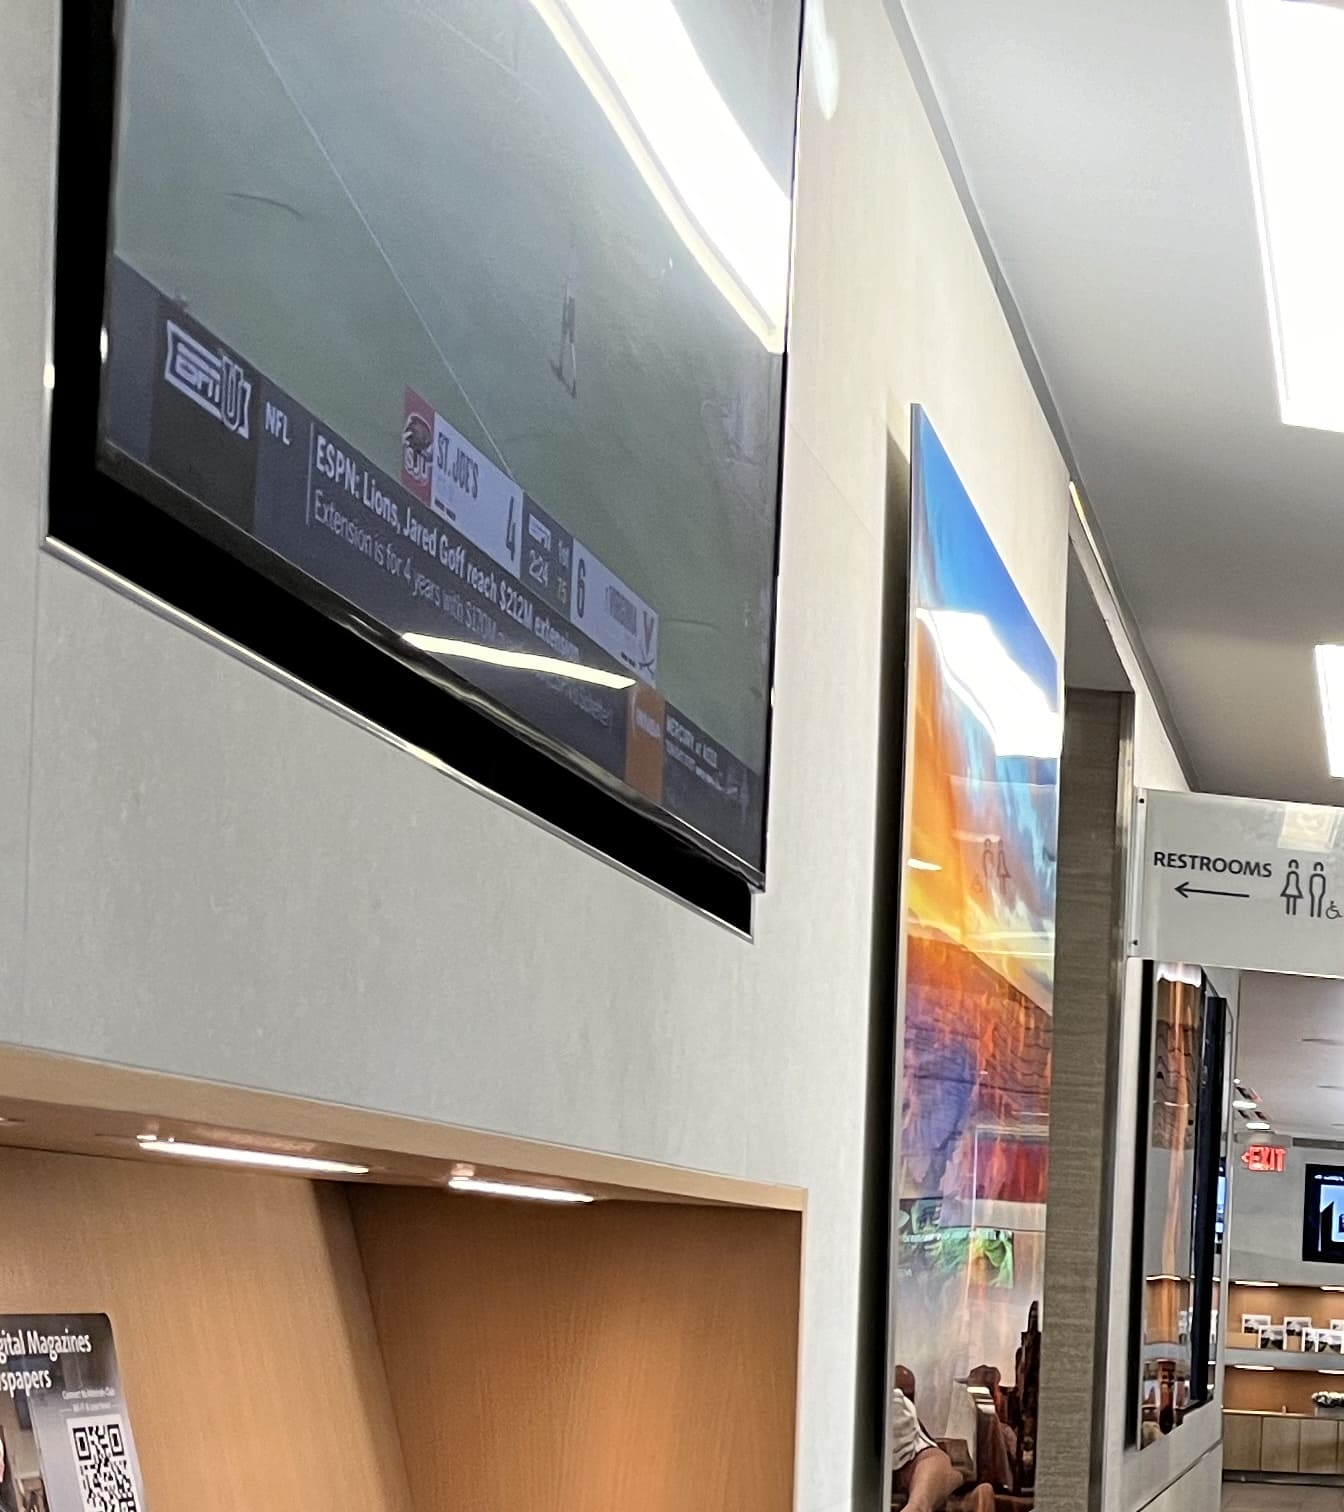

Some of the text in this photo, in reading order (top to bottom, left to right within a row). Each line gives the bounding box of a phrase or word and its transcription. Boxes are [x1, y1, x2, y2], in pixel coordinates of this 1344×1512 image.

[265, 401, 290, 446] NFL
[314, 488, 373, 558] Extension
[374, 536, 385, 566] is
[386, 542, 402, 576] for
[315, 434, 361, 499] ESPN:
[362, 471, 401, 534] Lions,
[403, 507, 437, 557] Jared
[439, 532, 466, 579] Goff
[466, 563, 498, 603] reach
[499, 579, 533, 633] $212M
[505, 496, 517, 562] 4
[576, 557, 586, 619] 6
[1153, 851, 1273, 879] RESTROOMS
[1248, 1145, 1286, 1172] EXIT
[27, 1328, 92, 1361] Magazines
